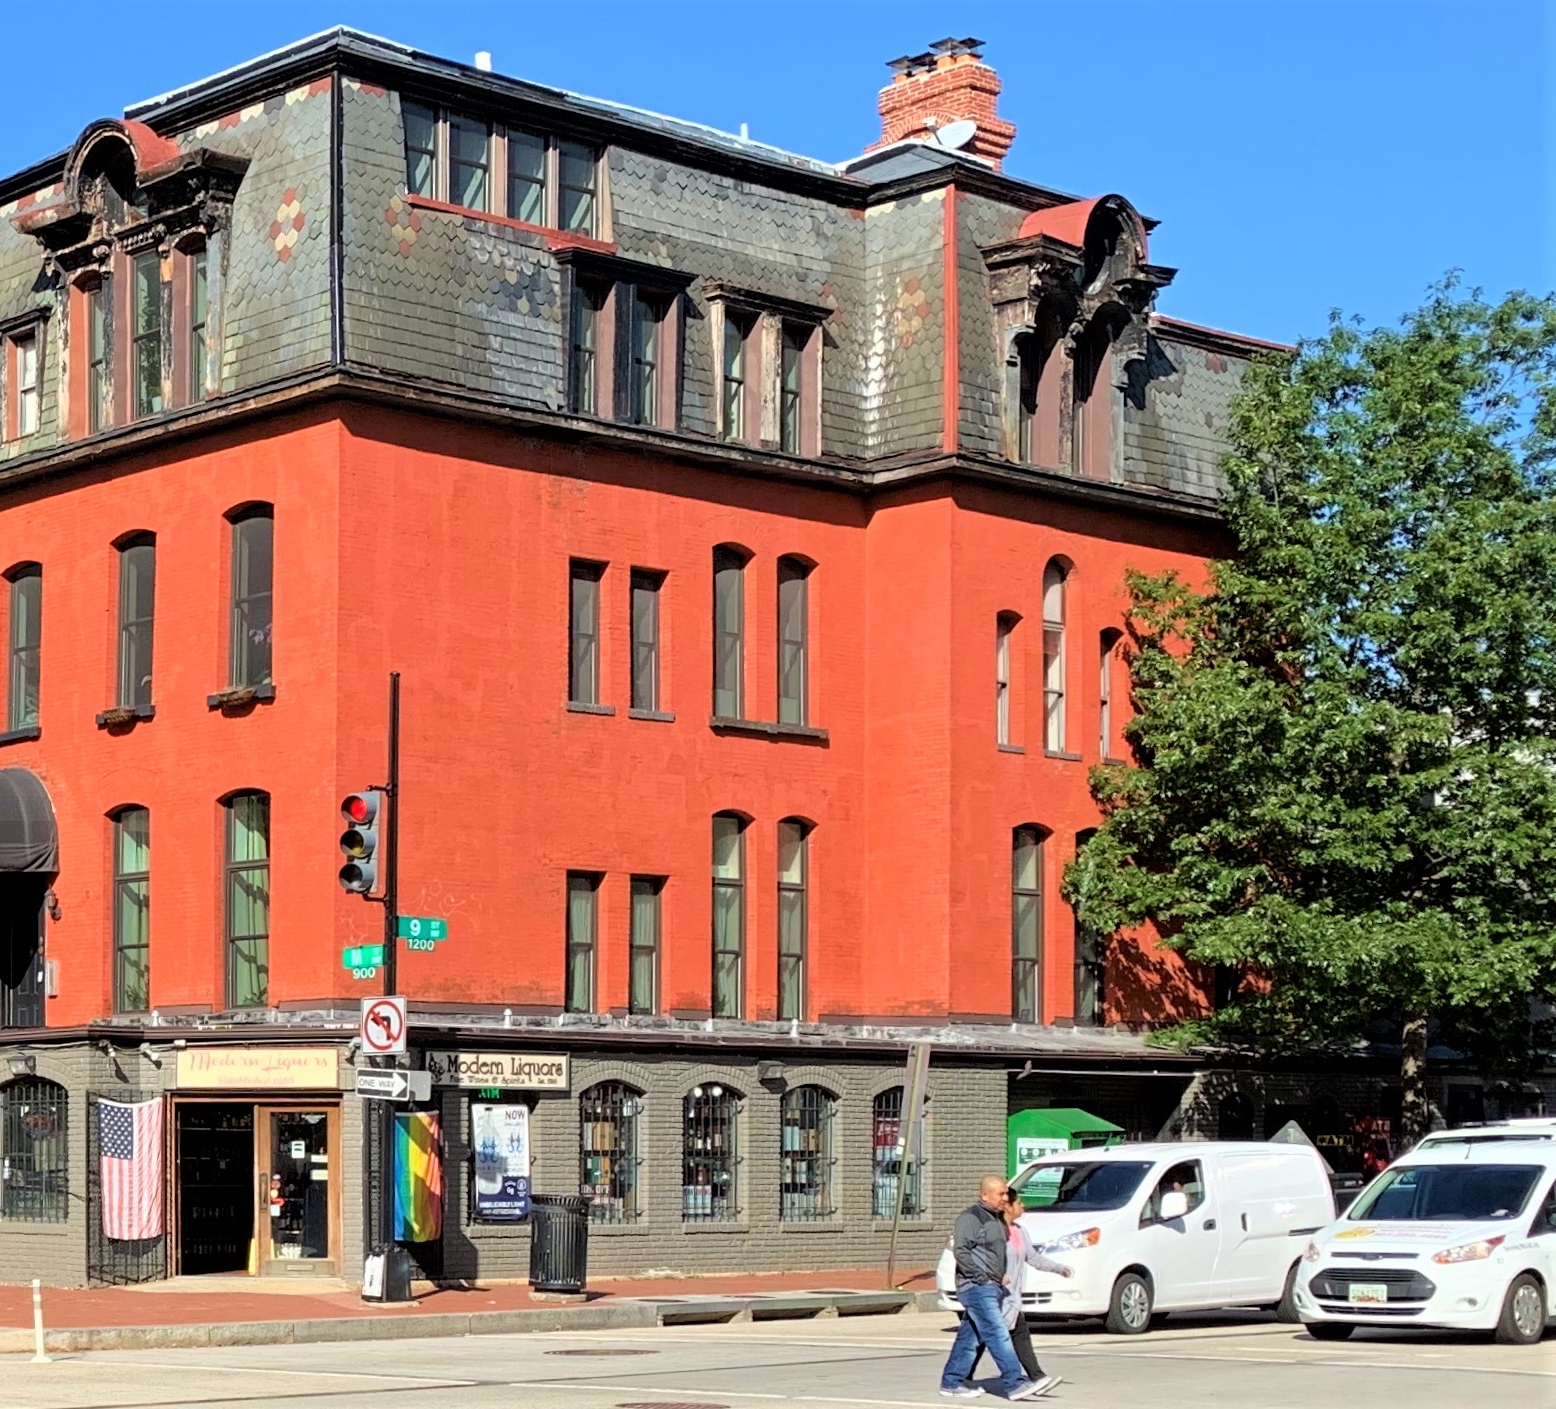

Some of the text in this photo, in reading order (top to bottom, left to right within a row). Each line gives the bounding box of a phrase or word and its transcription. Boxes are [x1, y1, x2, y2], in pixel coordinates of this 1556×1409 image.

[409, 919, 421, 936] 9
[408, 939, 434, 950] 1200
[352, 967, 376, 979] 900
[188, 1052, 259, 1071] Modern
[447, 1054, 563, 1082] Modern Liquors
[358, 1078, 376, 1087] ONE
[505, 1110, 525, 1119] NOW
